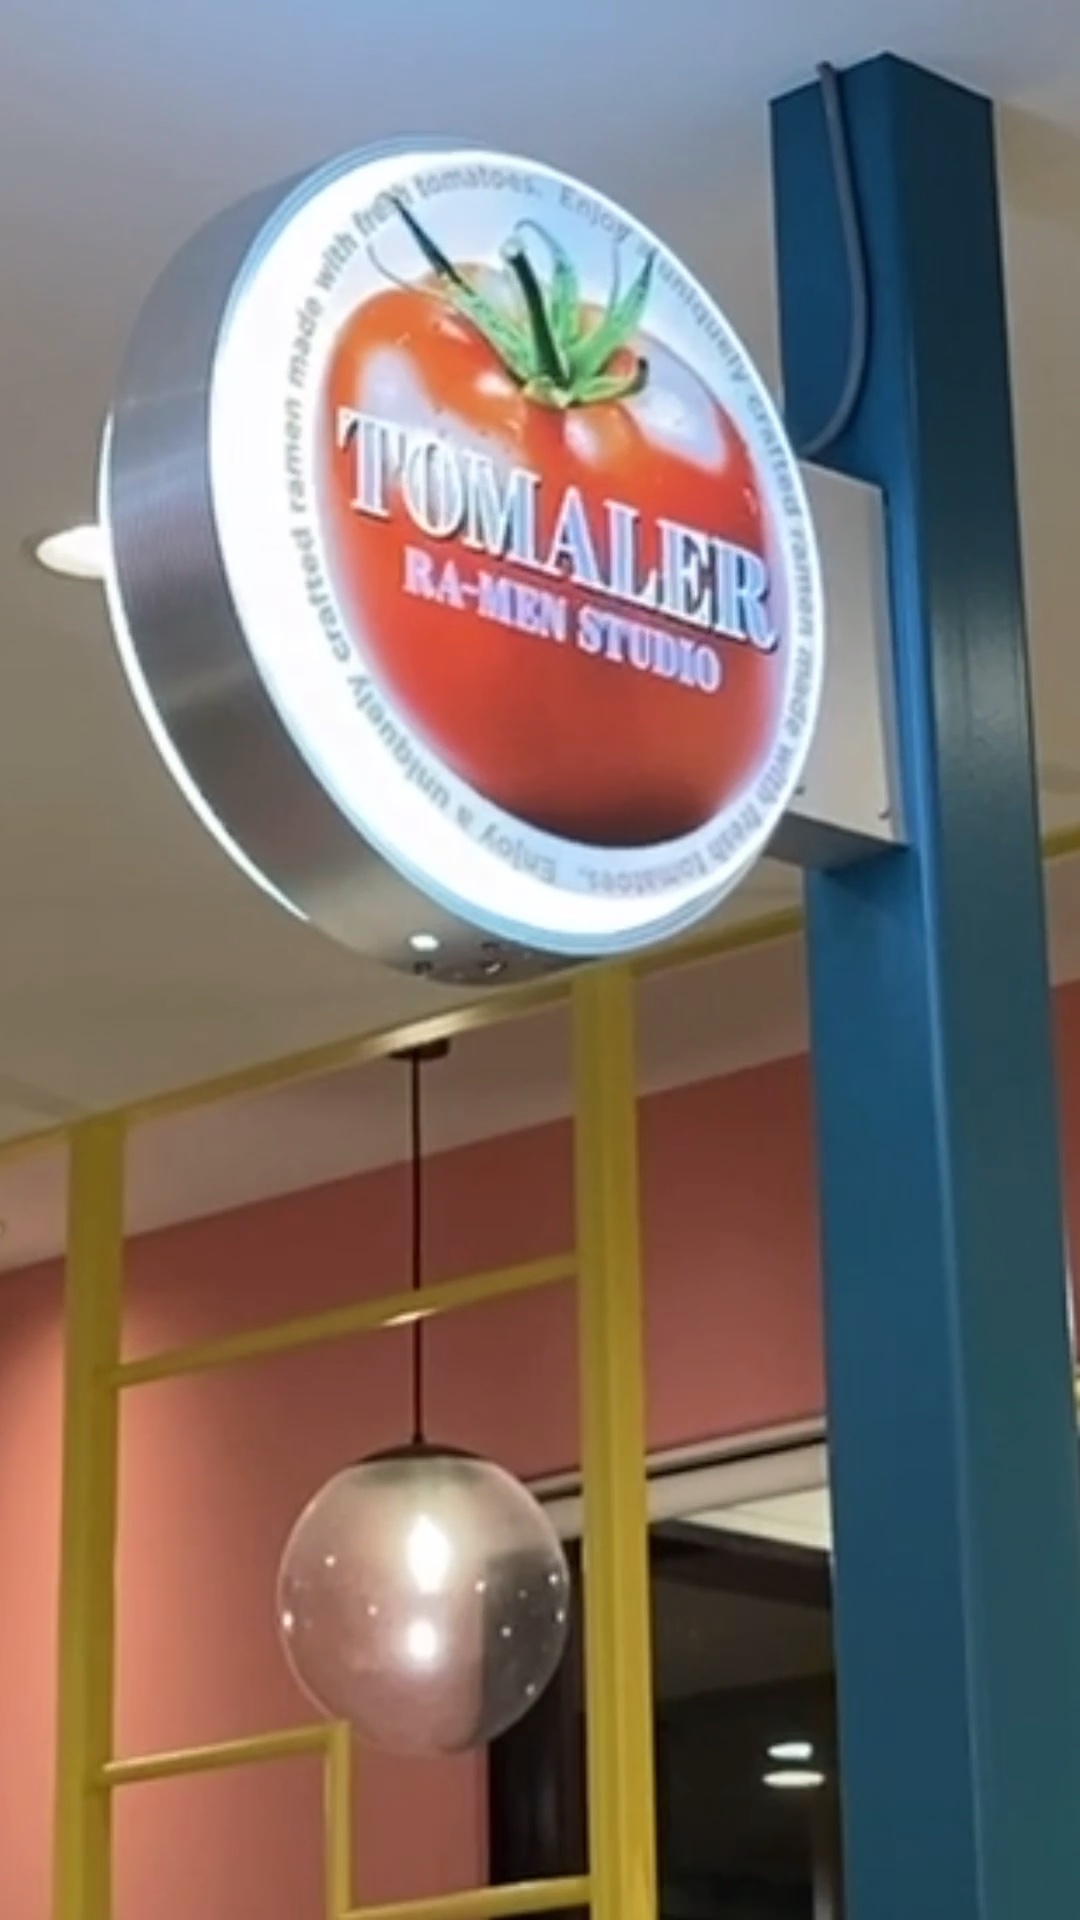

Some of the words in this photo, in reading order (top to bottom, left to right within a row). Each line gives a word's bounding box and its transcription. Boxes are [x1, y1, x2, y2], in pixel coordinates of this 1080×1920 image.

[314, 231, 359, 292] with
[286, 295, 324, 389] made
[284, 396, 308, 514] ramen
[558, 185, 633, 244] Enjoy
[657, 257, 750, 383] uniquely
[746, 393, 802, 517] crafted
[790, 528, 814, 638] ramen
[289, 525, 350, 662] crafted
[336, 405, 779, 654] TOMALER
[403, 545, 568, 644] RA-MEN
[577, 604, 724, 694] STUDIO
[346, 674, 450, 808] uniquely
[480, 822, 556, 884] Enjoy
